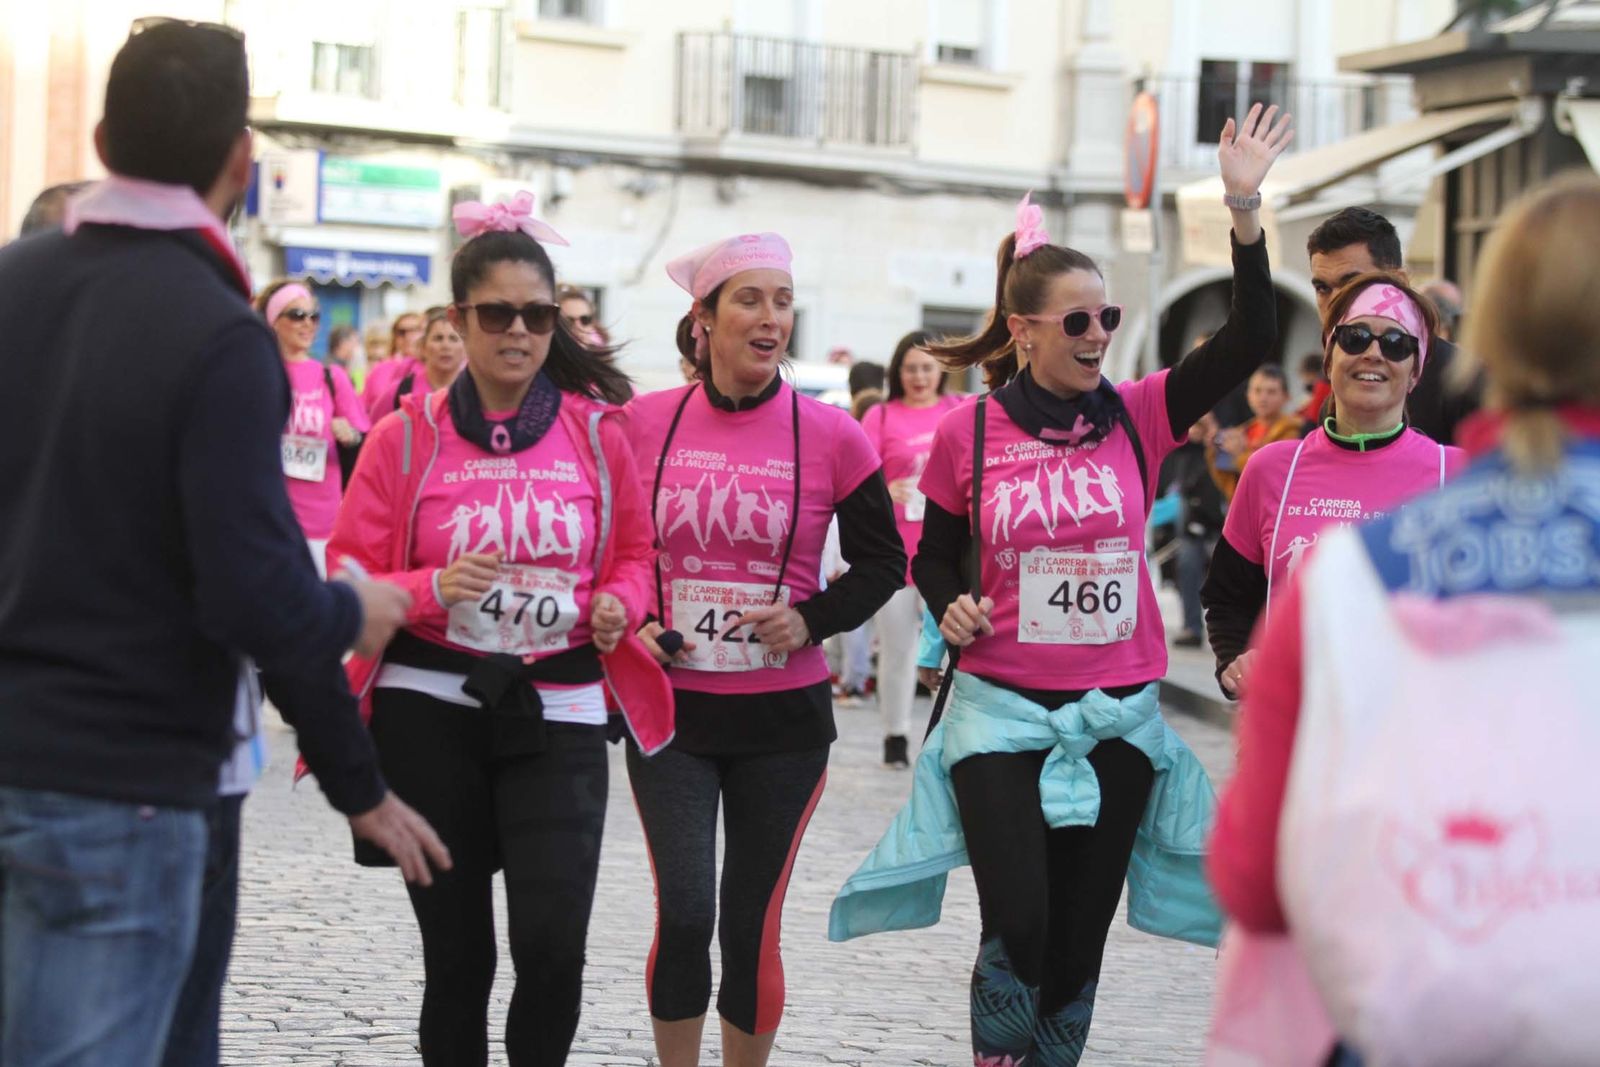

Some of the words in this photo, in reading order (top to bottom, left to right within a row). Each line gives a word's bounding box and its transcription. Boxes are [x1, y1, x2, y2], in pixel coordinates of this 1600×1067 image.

[464, 458, 517, 470] CARRERA
[554, 460, 578, 472] PINK
[677, 450, 727, 462] CARRERA
[766, 459, 795, 471] PINK
[986, 457, 999, 467] DE
[1002, 455, 1015, 463] LA
[1018, 449, 1055, 460] MUJER
[443, 472, 458, 483] DE
[461, 471, 476, 481] LA
[477, 469, 517, 480] MUJER
[529, 469, 580, 483] RUNNING
[670, 458, 683, 467] LA
[685, 458, 725, 471] MUJER
[738, 464, 795, 481] RUNNING
[1310, 498, 1361, 509] CARRERA
[1288, 506, 1301, 515] DE
[1304, 507, 1317, 516] LA
[1320, 508, 1360, 519] MUJER
[1046, 557, 1087, 567] CARRERA
[1116, 557, 1134, 566] PINK
[1027, 565, 1040, 574] DE
[1042, 566, 1054, 574] LA
[1056, 567, 1088, 576] MUJER
[1098, 566, 1134, 576] RUNNING
[694, 586, 733, 596] CARRERA
[1048, 580, 1122, 614] 466
[679, 593, 689, 602] DE
[691, 595, 700, 603] LA
[704, 596, 733, 605] MUJER
[480, 588, 560, 628] 470
[694, 608, 762, 643] 42
